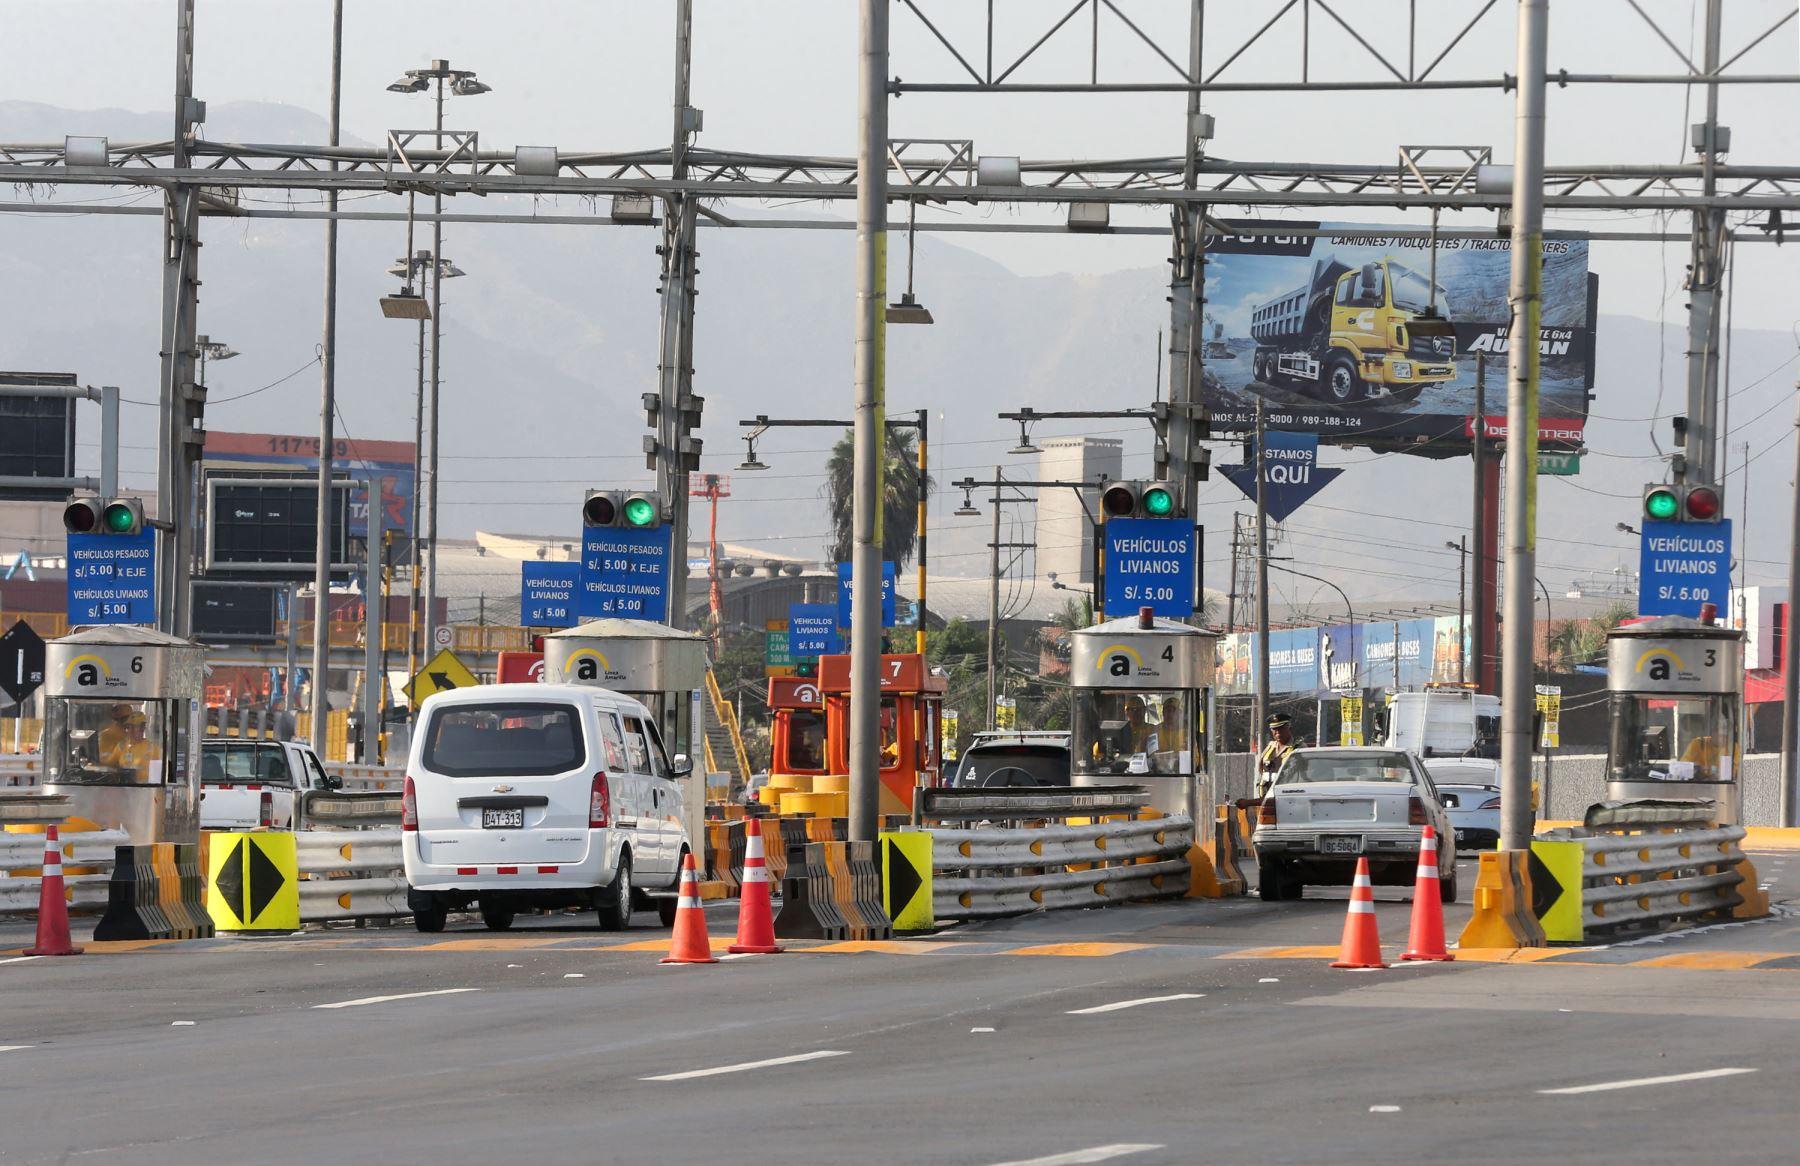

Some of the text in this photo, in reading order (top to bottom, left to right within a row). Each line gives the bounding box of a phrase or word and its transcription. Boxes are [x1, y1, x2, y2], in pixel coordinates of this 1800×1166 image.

[1302, 415, 1361, 427] 989-188-124
[1264, 449, 1313, 460] STAMOS
[587, 541, 663, 556] VEHÍCULOS PESADOS
[1113, 536, 1187, 553] VEHÍCULOS
[1648, 535, 1725, 554] VEHÍCULOS
[73, 548, 149, 559] VEHÍCULOS PESADOS
[89, 565, 113, 575] 5.00
[126, 568, 147, 577] EJE
[604, 560, 627, 570] 5.00
[639, 563, 660, 574] EJE
[1120, 560, 1179, 574] LIVIANOS
[1655, 559, 1717, 574] LIVIANOS
[526, 577, 573, 588] VEHÍCULOS
[585, 581, 660, 595] VEHÍCULOS LIVIANOS
[73, 588, 149, 599] VEHÍCULOS LIVIANOS
[531, 591, 569, 600] LIVIANOS
[1124, 585, 1174, 600] S/. 5.00
[1659, 586, 1709, 600] S/. 5.00
[103, 604, 127, 615] 5.00
[547, 607, 566, 618] 5.00
[618, 600, 641, 611] 5.00
[1161, 644, 1174, 662] 4
[1704, 649, 1716, 667] 3
[131, 656, 143, 673] 6
[891, 661, 902, 677] 7
[485, 813, 521, 826] D4T-313
